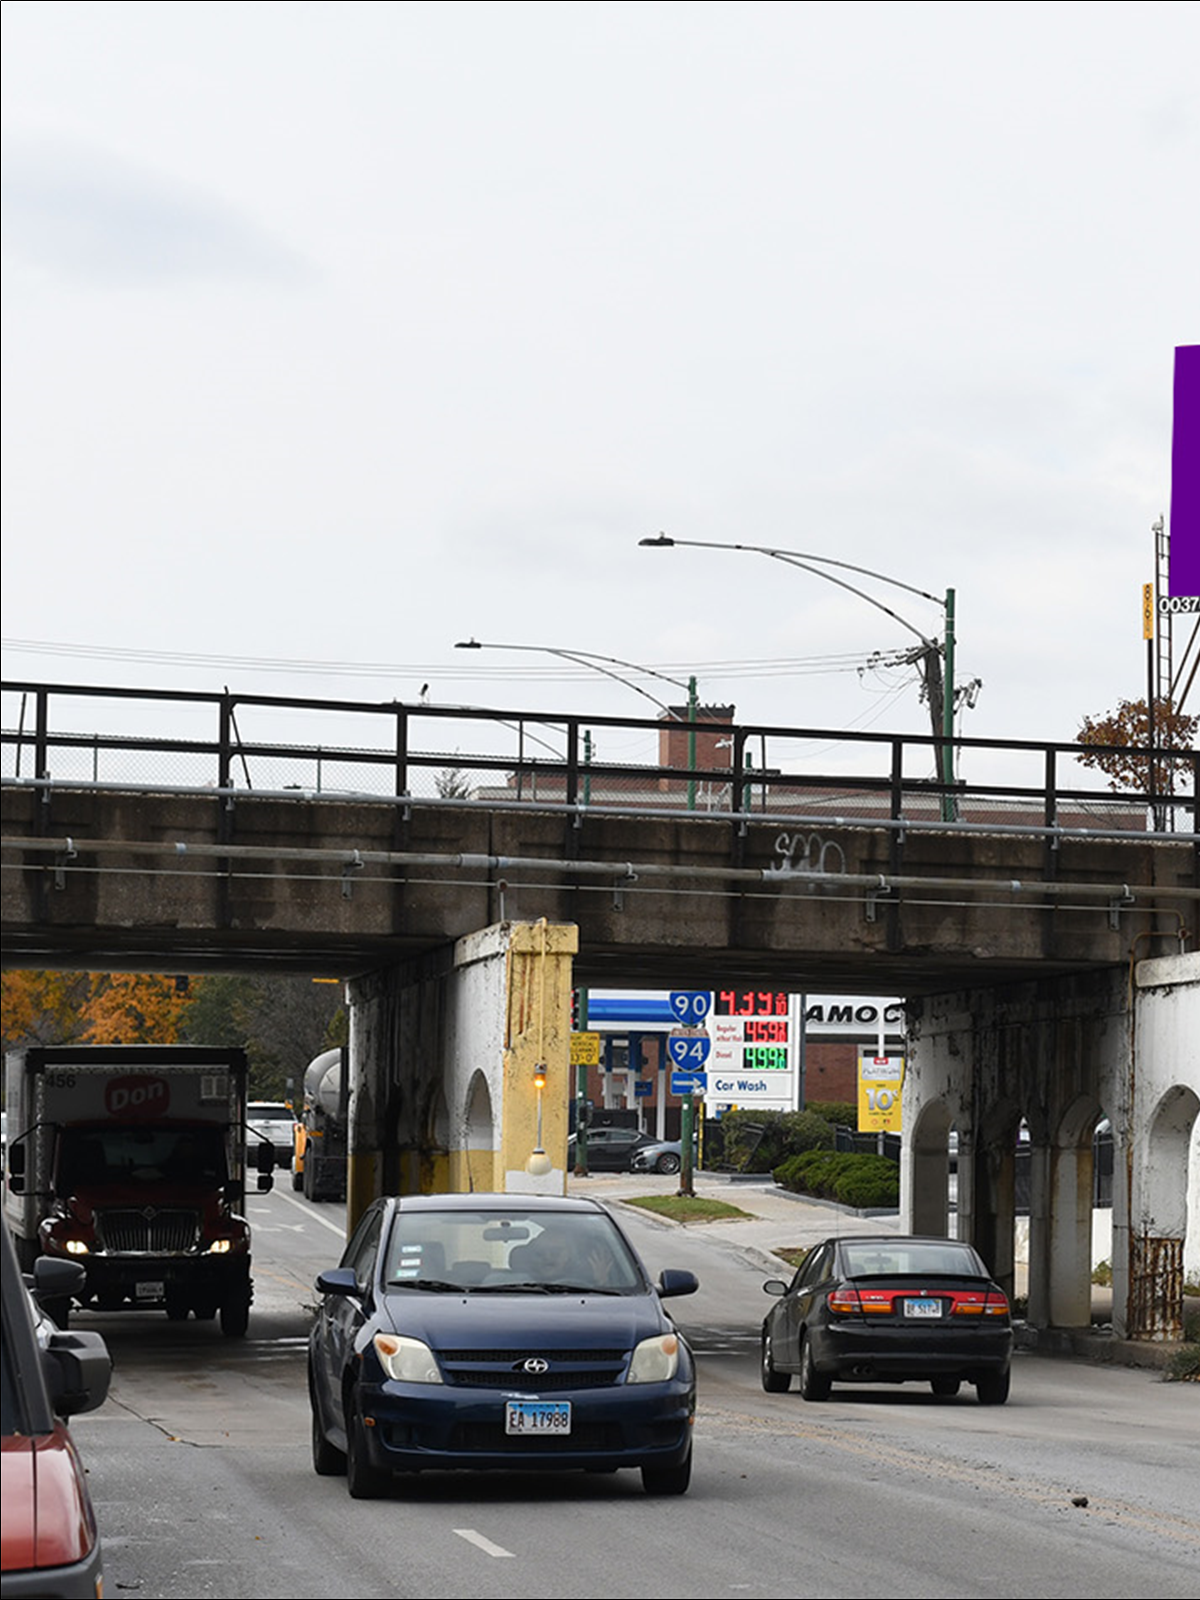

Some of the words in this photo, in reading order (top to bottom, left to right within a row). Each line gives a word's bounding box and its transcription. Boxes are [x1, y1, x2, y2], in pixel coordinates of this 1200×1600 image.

[675, 995, 707, 1016] 90
[674, 1041, 704, 1061] 94
[715, 1080, 734, 1091] Car
[737, 1080, 767, 1091] Wash
[110, 1081, 164, 1112] Don
[510, 1411, 525, 1428] EA
[531, 1411, 568, 1428] 17988
